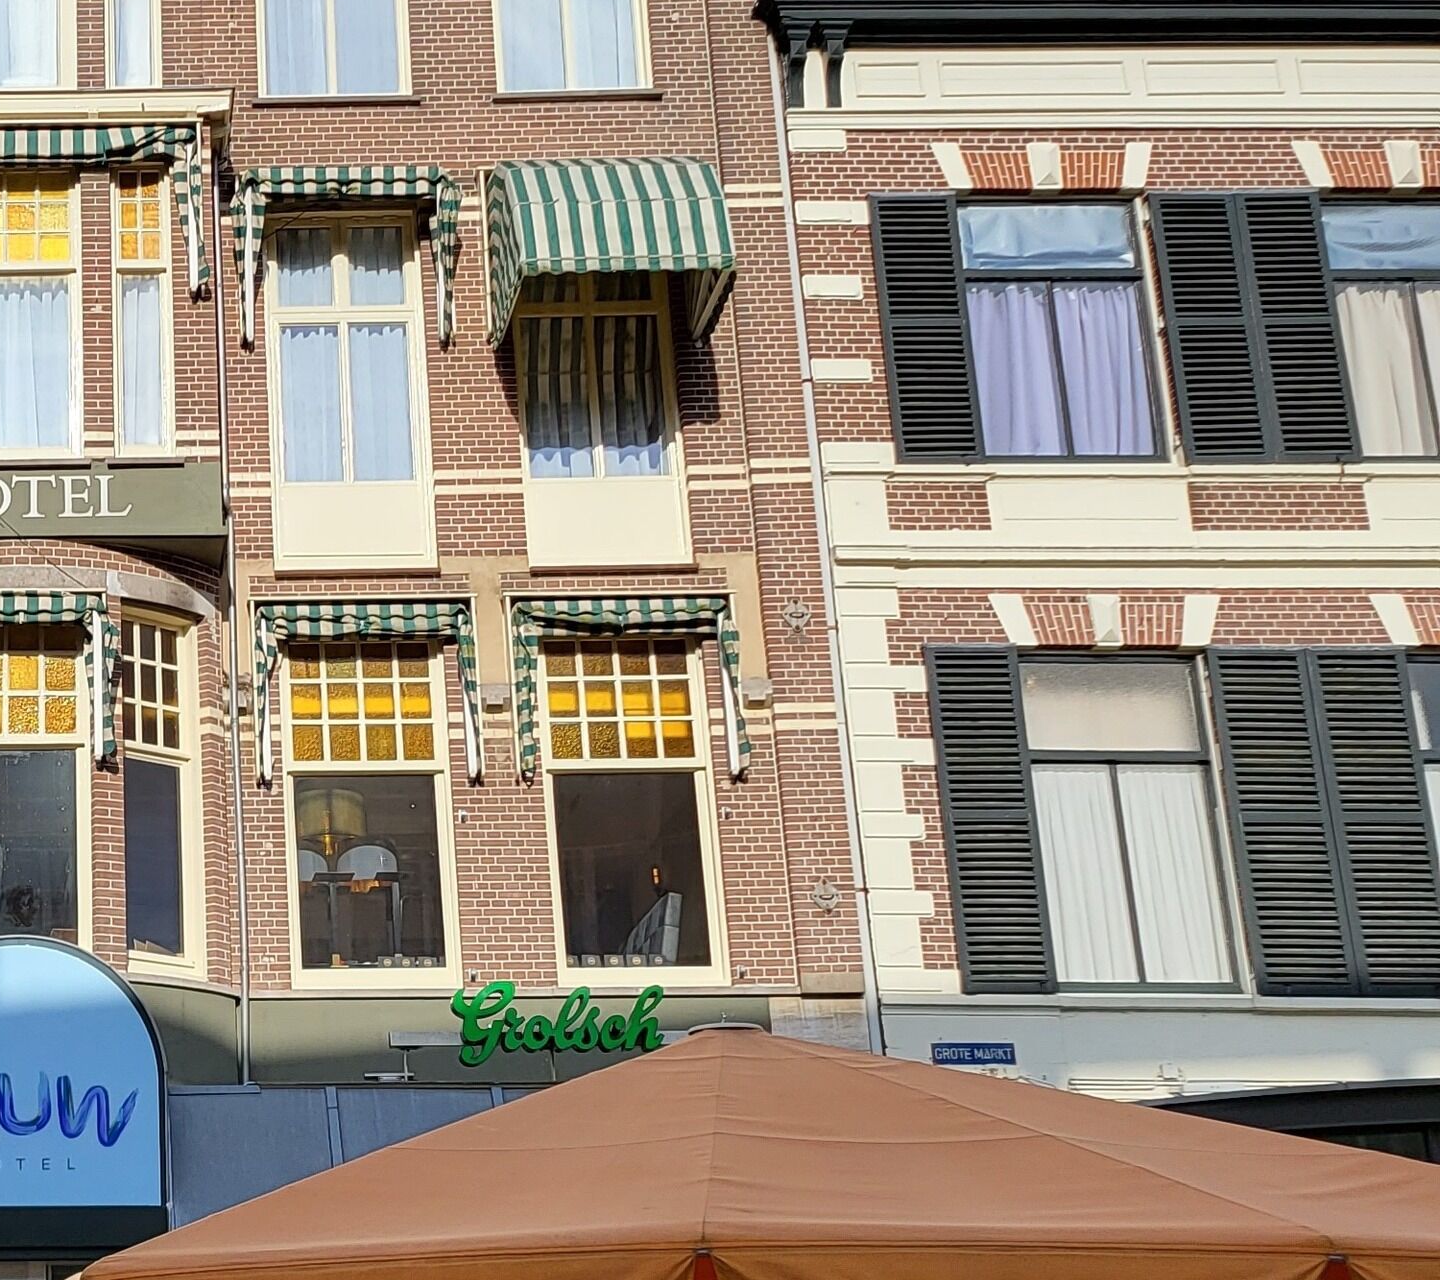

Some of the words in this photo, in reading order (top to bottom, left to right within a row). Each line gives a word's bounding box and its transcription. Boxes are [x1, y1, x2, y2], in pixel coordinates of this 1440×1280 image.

[451, 981, 664, 1067] Grolsch
[934, 1048, 972, 1060] GROTE
[974, 1048, 1012, 1060] MARKT
